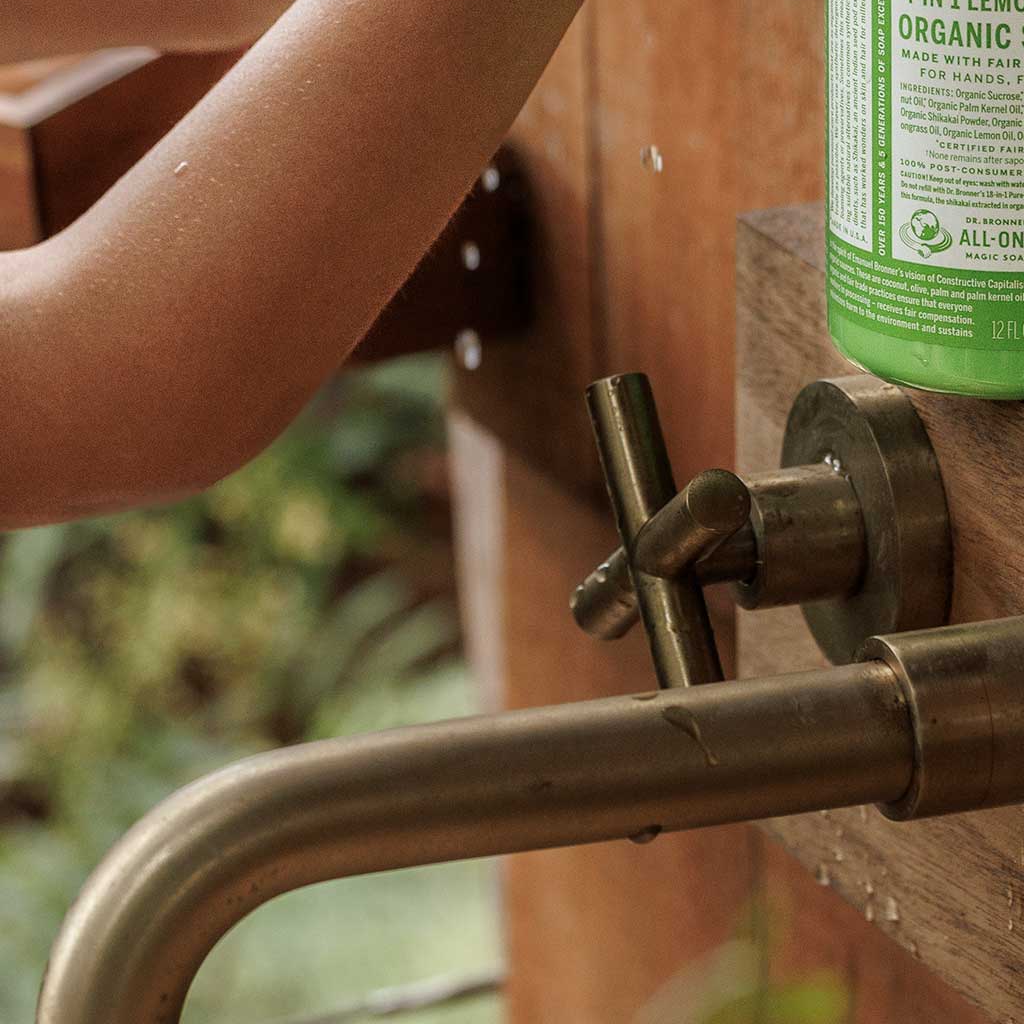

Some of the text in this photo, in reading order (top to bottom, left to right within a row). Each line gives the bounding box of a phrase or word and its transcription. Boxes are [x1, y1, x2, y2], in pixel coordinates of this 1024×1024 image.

[898, 14, 1011, 50] ORGANIC
[878, 60, 885, 72] OF
[902, 48, 938, 63] MADE
[944, 54, 980, 66] WITH
[988, 58, 1020, 68] FAIR
[920, 68, 946, 80] FOR
[953, 72, 1010, 85] HANDS,
[900, 82, 954, 96] INGREDIENTS:
[956, 88, 986, 100] Organic
[928, 98, 957, 111] Organic
[960, 102, 979, 112] Palm
[981, 104, 1008, 114] Kernel
[900, 108, 926, 120] Organic
[928, 112, 958, 124] Shikakai
[960, 116, 990, 127] Powder,
[992, 118, 1022, 129] Organic
[900, 122, 928, 134] ongrass
[929, 125, 942, 136] Oil,
[942, 127, 972, 139] Organic
[974, 130, 1000, 140] Lemon
[1002, 131, 1016, 141] Oil,
[900, 158, 926, 169] 100%
[930, 163, 1022, 176] POST-CONSUMER
[950, 154, 982, 163] remains
[966, 252, 998, 260] MAGIC
[872, 274, 880, 284] are
[882, 277, 909, 292] coconut,
[910, 284, 928, 295] olive,
[930, 288, 949, 298] palm
[950, 288, 964, 298] and
[966, 290, 987, 302] palm
[988, 292, 1013, 302] kernel
[905, 270, 926, 281] vision
[928, 274, 936, 282] of
[936, 274, 986, 288] Constructive
[897, 294, 920, 306] ensure
[922, 298, 937, 308] that
[938, 300, 972, 313] everyone
[877, 302, 974, 325] receives fair compensation.
[876, 314, 973, 338] environment and sustains
[992, 320, 1004, 340] 12
[1008, 321, 1019, 340] FL
